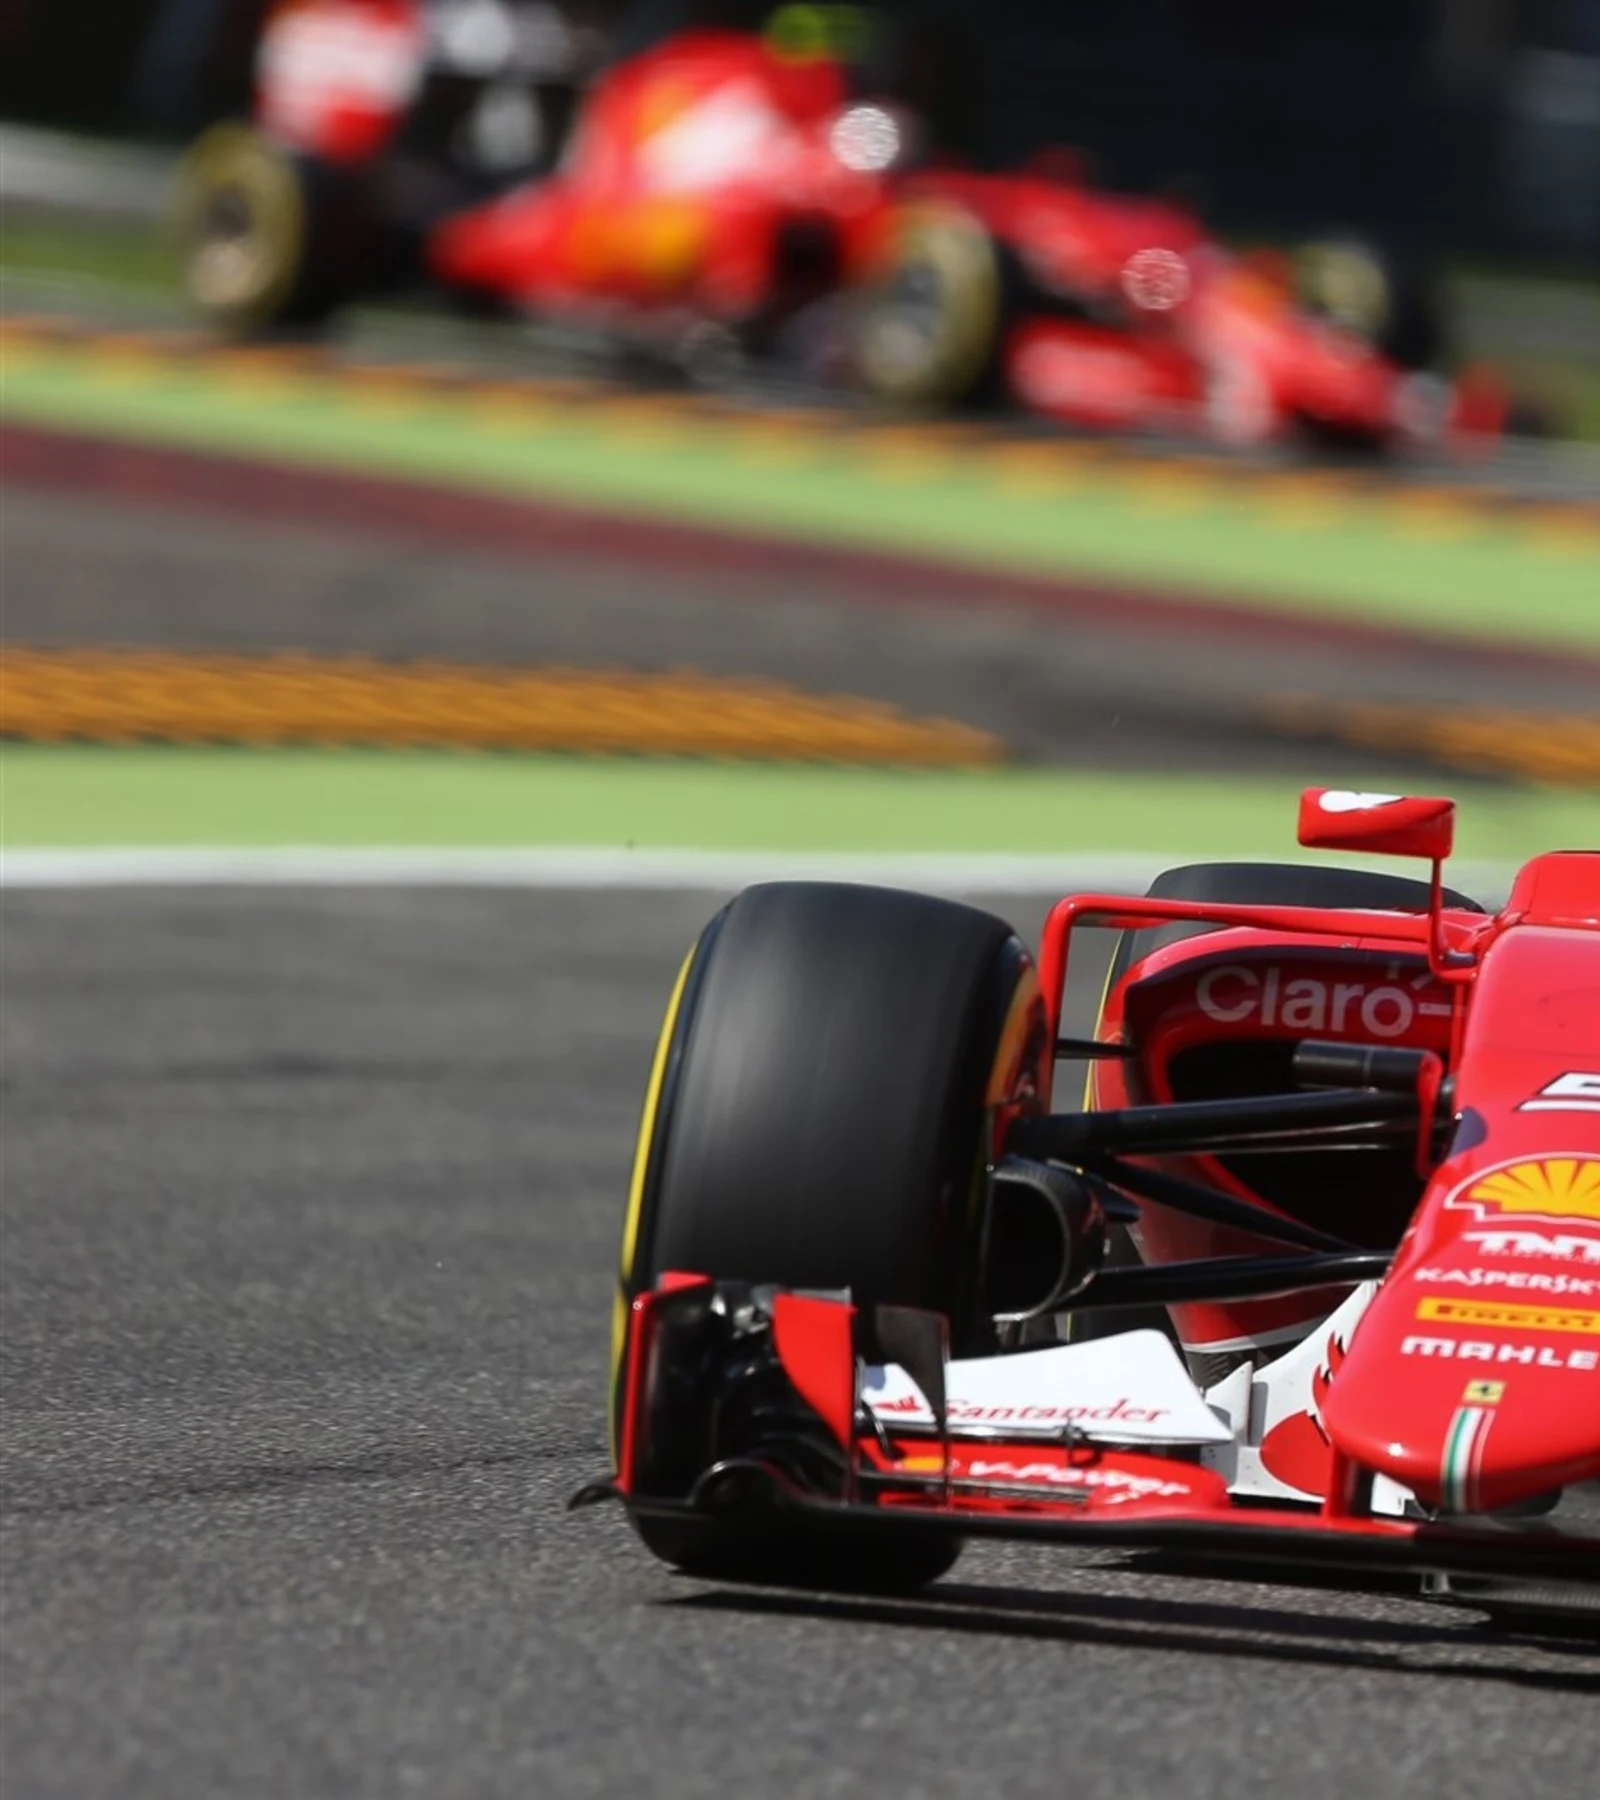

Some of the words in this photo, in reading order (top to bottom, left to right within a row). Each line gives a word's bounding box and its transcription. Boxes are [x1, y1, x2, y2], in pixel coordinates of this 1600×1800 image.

[1196, 965, 1413, 1037] Claro
[1400, 1336, 1600, 1369] MAHLE
[945, 1398, 1171, 1422] Santander
